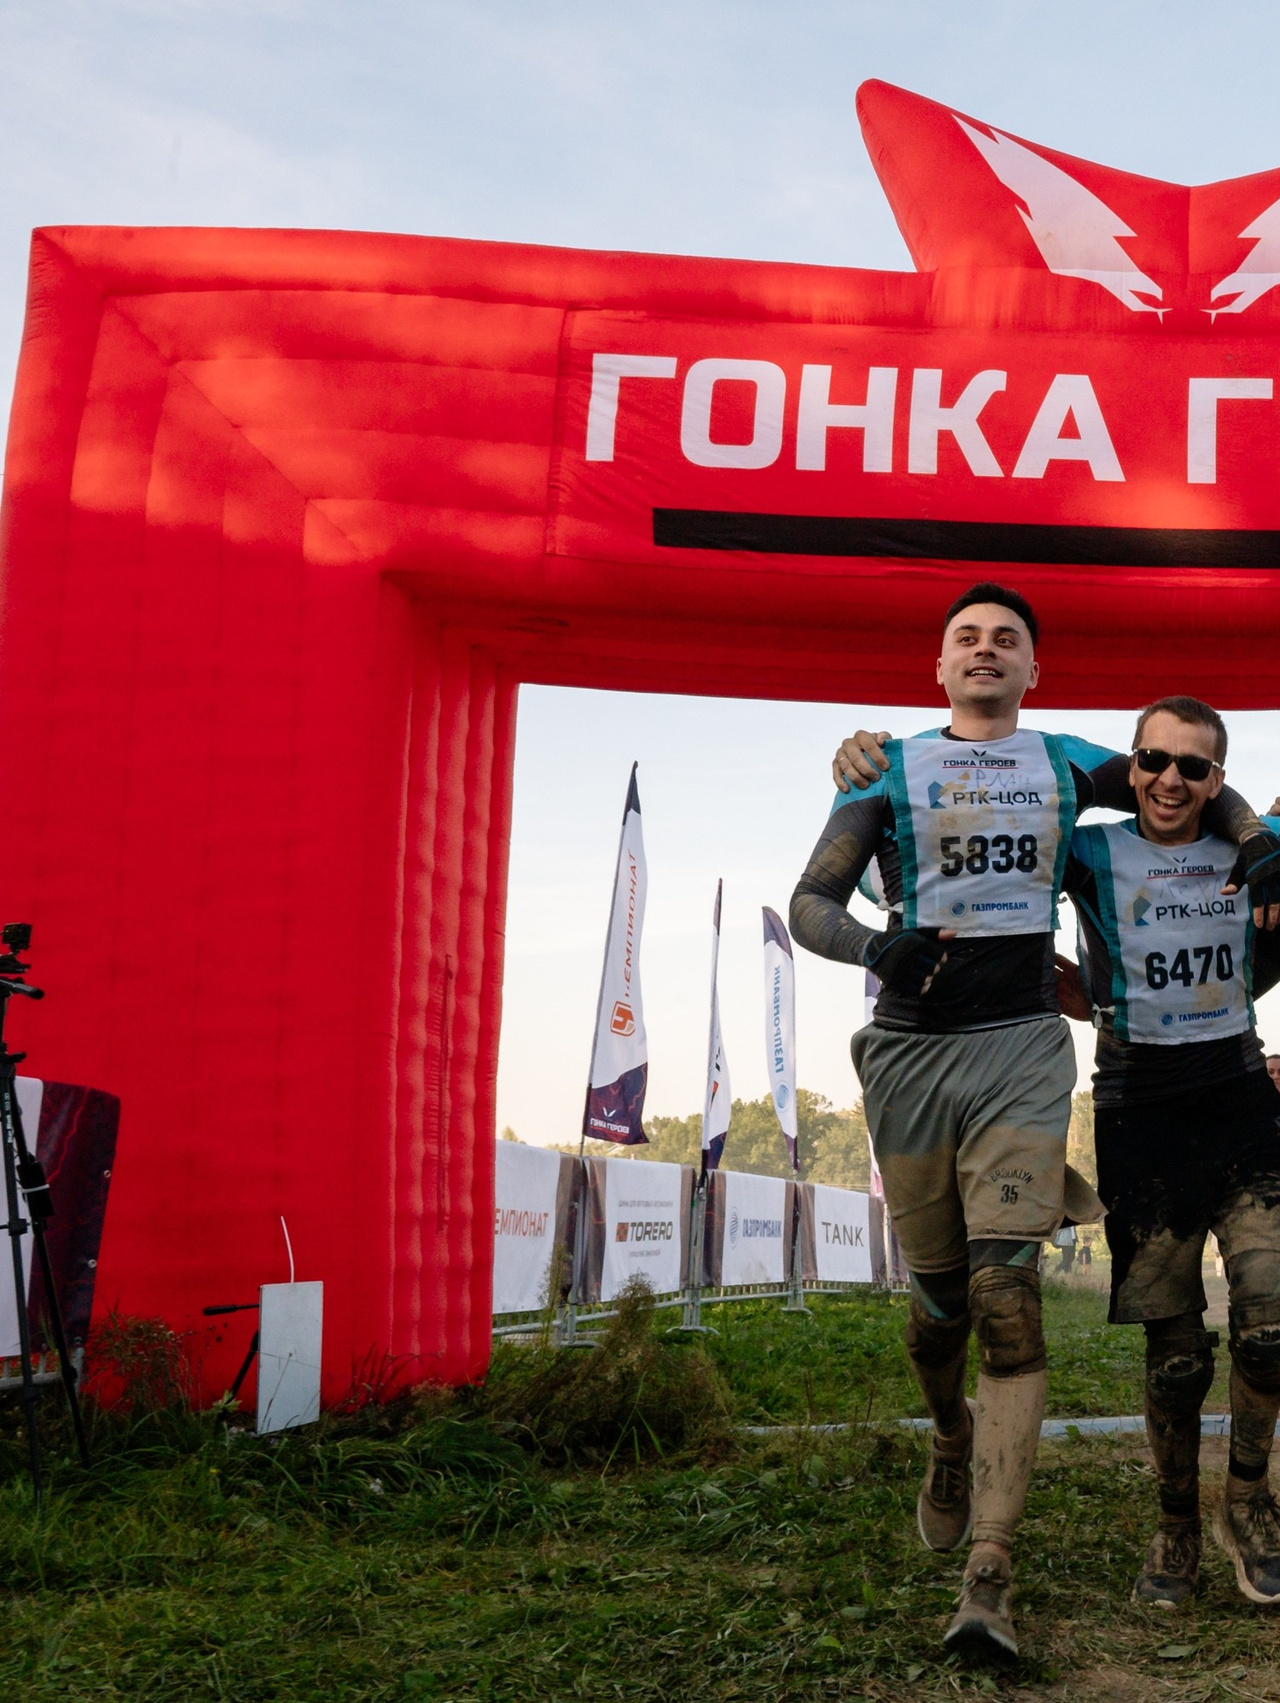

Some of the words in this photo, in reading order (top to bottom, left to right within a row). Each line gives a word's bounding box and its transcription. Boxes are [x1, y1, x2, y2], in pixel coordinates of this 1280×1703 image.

[585, 353, 1126, 482] ГОНКА
[979, 759, 1016, 767] ГЕРОЕВ
[952, 791, 1042, 805] РТК-ЦОД
[940, 834, 1037, 877] 5838
[1148, 867, 1179, 876] ГОНКА
[1182, 864, 1215, 874] ГЕРОЕВ
[971, 902, 1029, 912] ГАЗПРОМБАНК
[1155, 900, 1235, 920] РТК-ЦОД
[1145, 943, 1234, 990] 6470
[1179, 1007, 1230, 1022] ГАЗПРОМБАНК
[990, 1168, 1034, 1184] BROOKLYN
[1000, 1183, 1019, 1205] 35
[495, 1208, 548, 1237] ЕМПИОНАТ
[630, 1221, 673, 1242] TORERO
[821, 1221, 865, 1248] TANK
